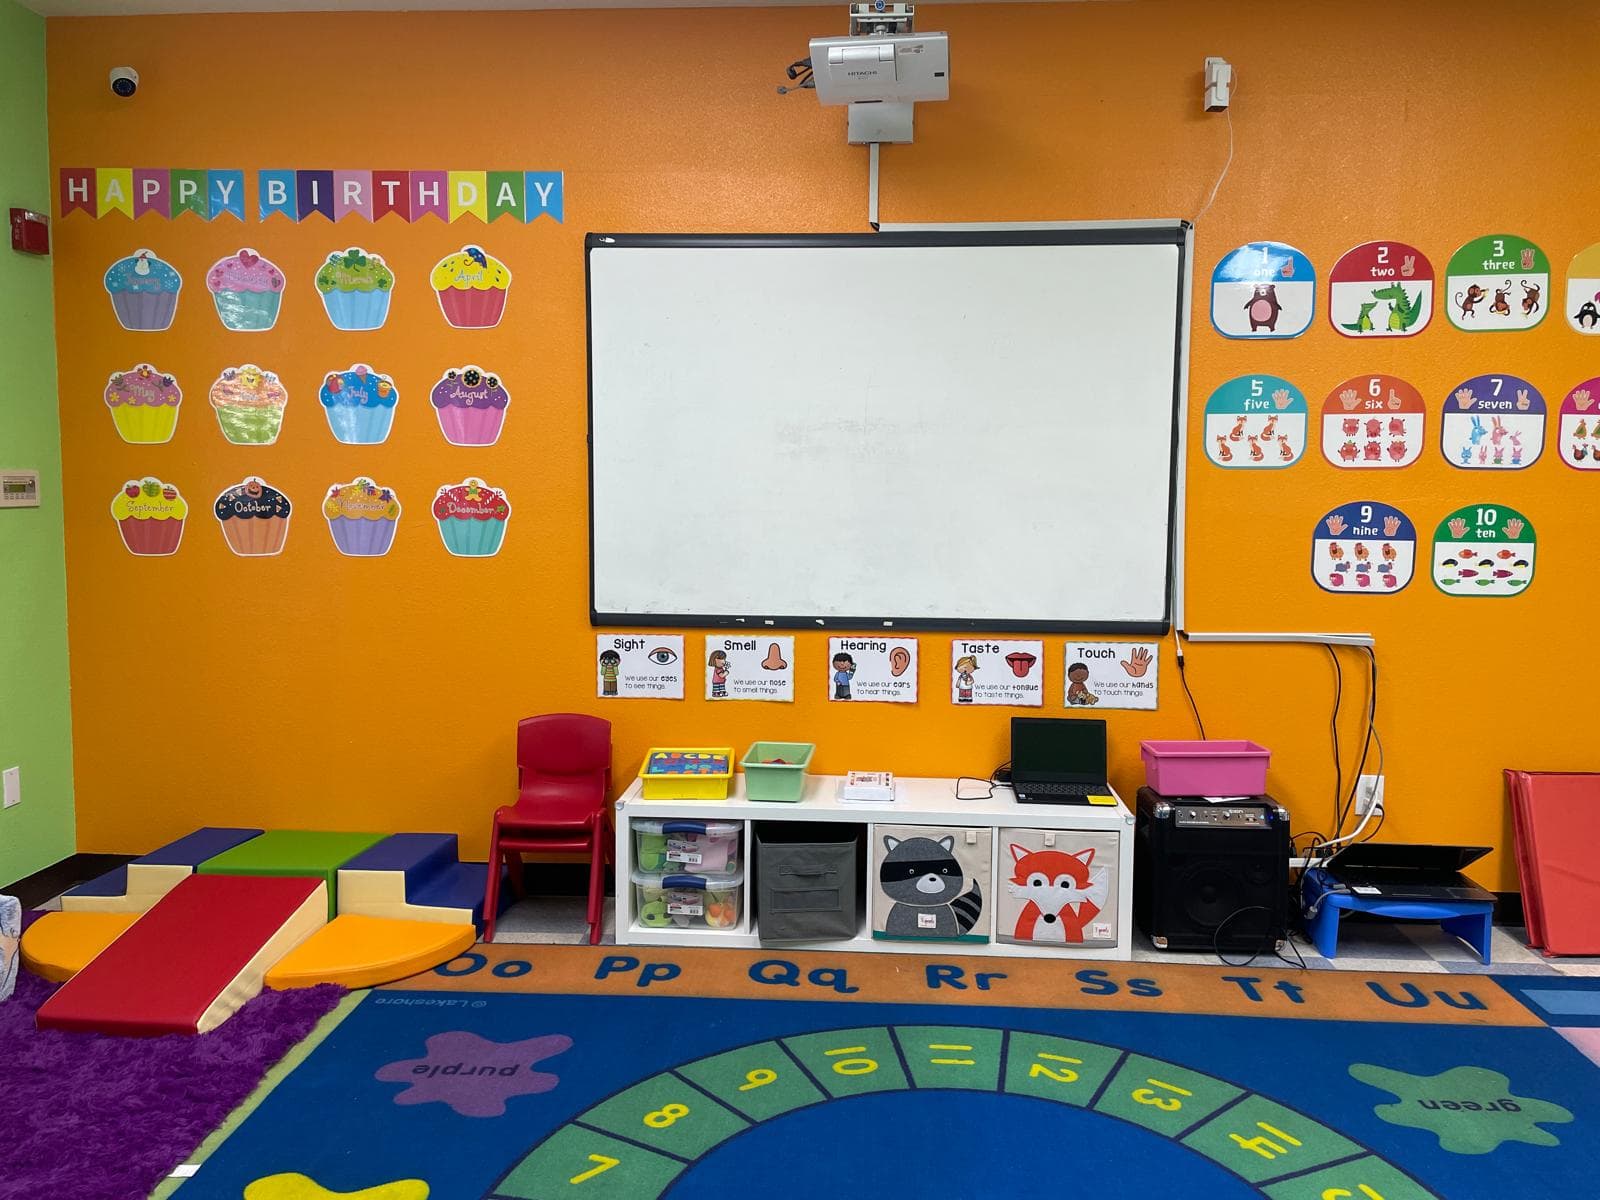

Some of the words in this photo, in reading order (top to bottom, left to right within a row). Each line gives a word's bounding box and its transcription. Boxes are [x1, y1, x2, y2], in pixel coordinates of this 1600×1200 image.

[68, 177, 235, 204] HAPPY
[268, 180, 554, 207] BIRTHDAY
[1262, 246, 1269, 264] 1
[1377, 246, 1389, 264] 2
[1493, 240, 1505, 257] 3
[1254, 268, 1275, 277] one
[1370, 266, 1395, 277] two
[1482, 259, 1515, 270] three
[455, 270, 483, 287] April
[348, 386, 369, 404] July
[450, 386, 489, 405] August
[1251, 379, 1263, 397] 5
[1369, 378, 1381, 397] 6
[1490, 378, 1503, 396] 7
[1244, 398, 1270, 411] five
[1365, 399, 1383, 409] six
[1478, 400, 1512, 410] seven
[127, 500, 174, 516] September
[234, 501, 272, 513] October
[447, 502, 497, 515] December
[1360, 505, 1373, 523] 9
[1475, 508, 1497, 526] 10
[1352, 526, 1379, 536] nine
[1475, 528, 1496, 538] ten
[614, 638, 646, 652] Sight
[724, 640, 757, 651] Smell
[841, 640, 887, 653] Hearing
[962, 643, 1000, 654] Taste
[1077, 648, 1116, 659] Touch
[856, 680, 867, 688] We
[431, 953, 532, 978] Oo
[594, 955, 682, 987] Pp
[748, 959, 860, 994] Qq
[925, 964, 1008, 991] Rr
[1074, 969, 1163, 997] Ss
[1221, 976, 1305, 1004] Tt
[1365, 981, 1488, 1011] Uu
[824, 1046, 879, 1076] 10
[928, 1044, 976, 1065] 11
[412, 1062, 520, 1078] purple
[1029, 1053, 1083, 1083] 12
[738, 1068, 778, 1092] 9
[1132, 1078, 1193, 1111] 13
[1418, 1098, 1521, 1114] green
[643, 1103, 690, 1128] 8
[1228, 1121, 1303, 1160] 14
[569, 1153, 621, 1185] 7
